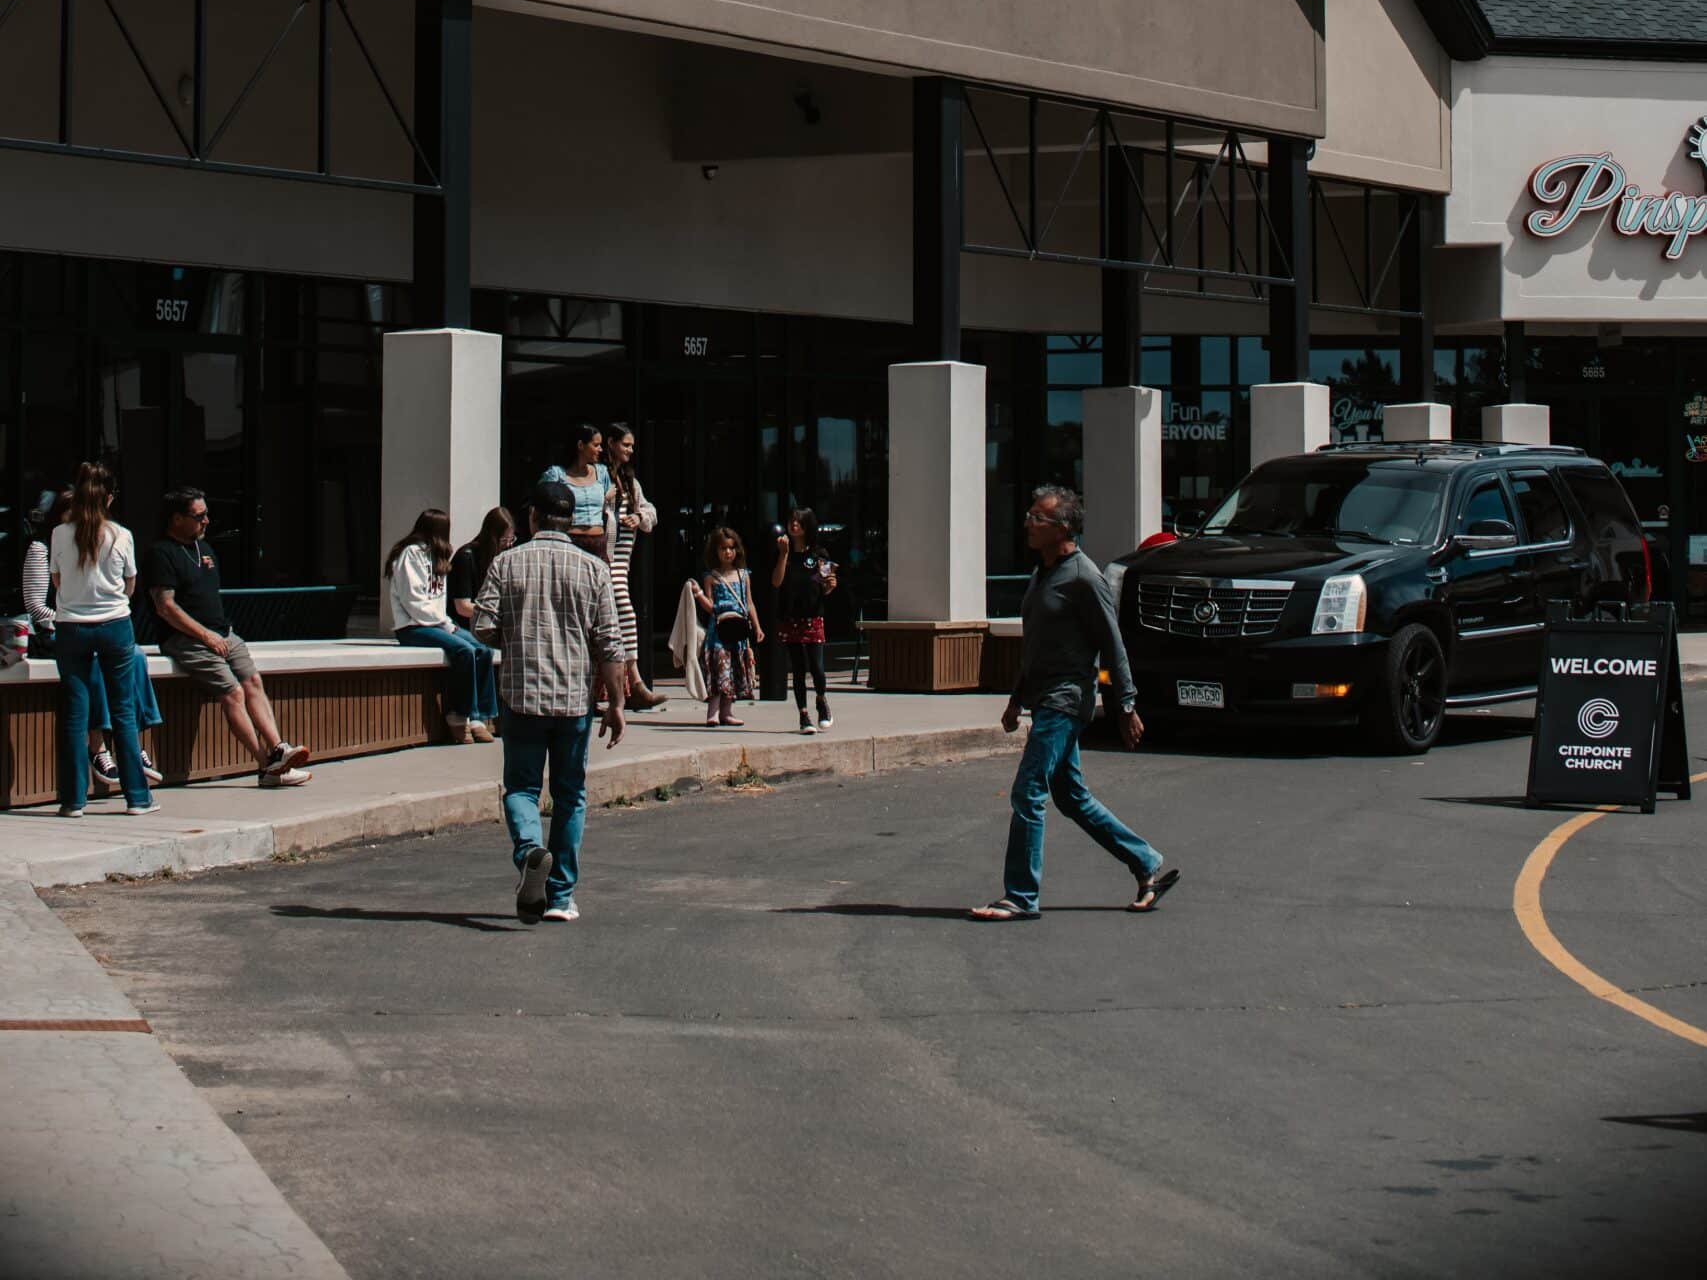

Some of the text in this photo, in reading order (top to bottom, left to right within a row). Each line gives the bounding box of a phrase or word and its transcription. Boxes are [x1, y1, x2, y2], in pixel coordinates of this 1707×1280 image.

[156, 299, 188, 322] 5657
[684, 336, 708, 356] 5657
[1170, 401, 1200, 421] Fun
[1551, 658, 1657, 676] WELCOME
[1559, 745, 1632, 758] CITIPOINTE
[1565, 759, 1622, 770] CHURCH
